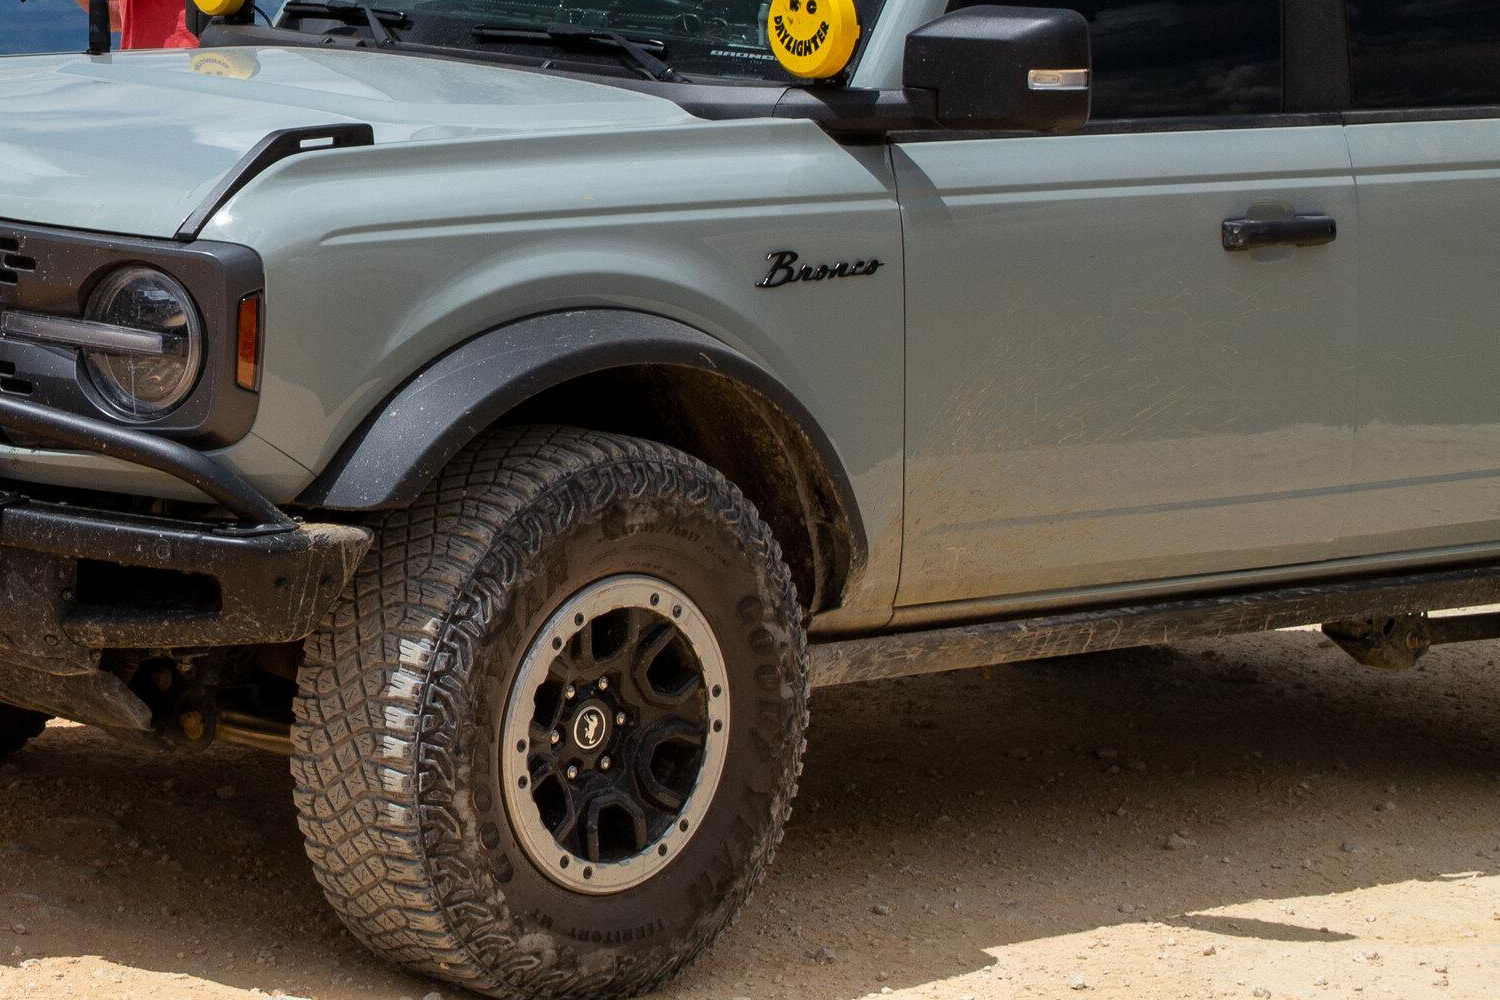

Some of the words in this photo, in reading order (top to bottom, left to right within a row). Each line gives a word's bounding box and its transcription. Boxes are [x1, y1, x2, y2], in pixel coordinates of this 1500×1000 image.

[710, 49, 778, 61] BRONC
[773, 15, 830, 57] DAYLIGHTER
[755, 250, 885, 288] Bronco
